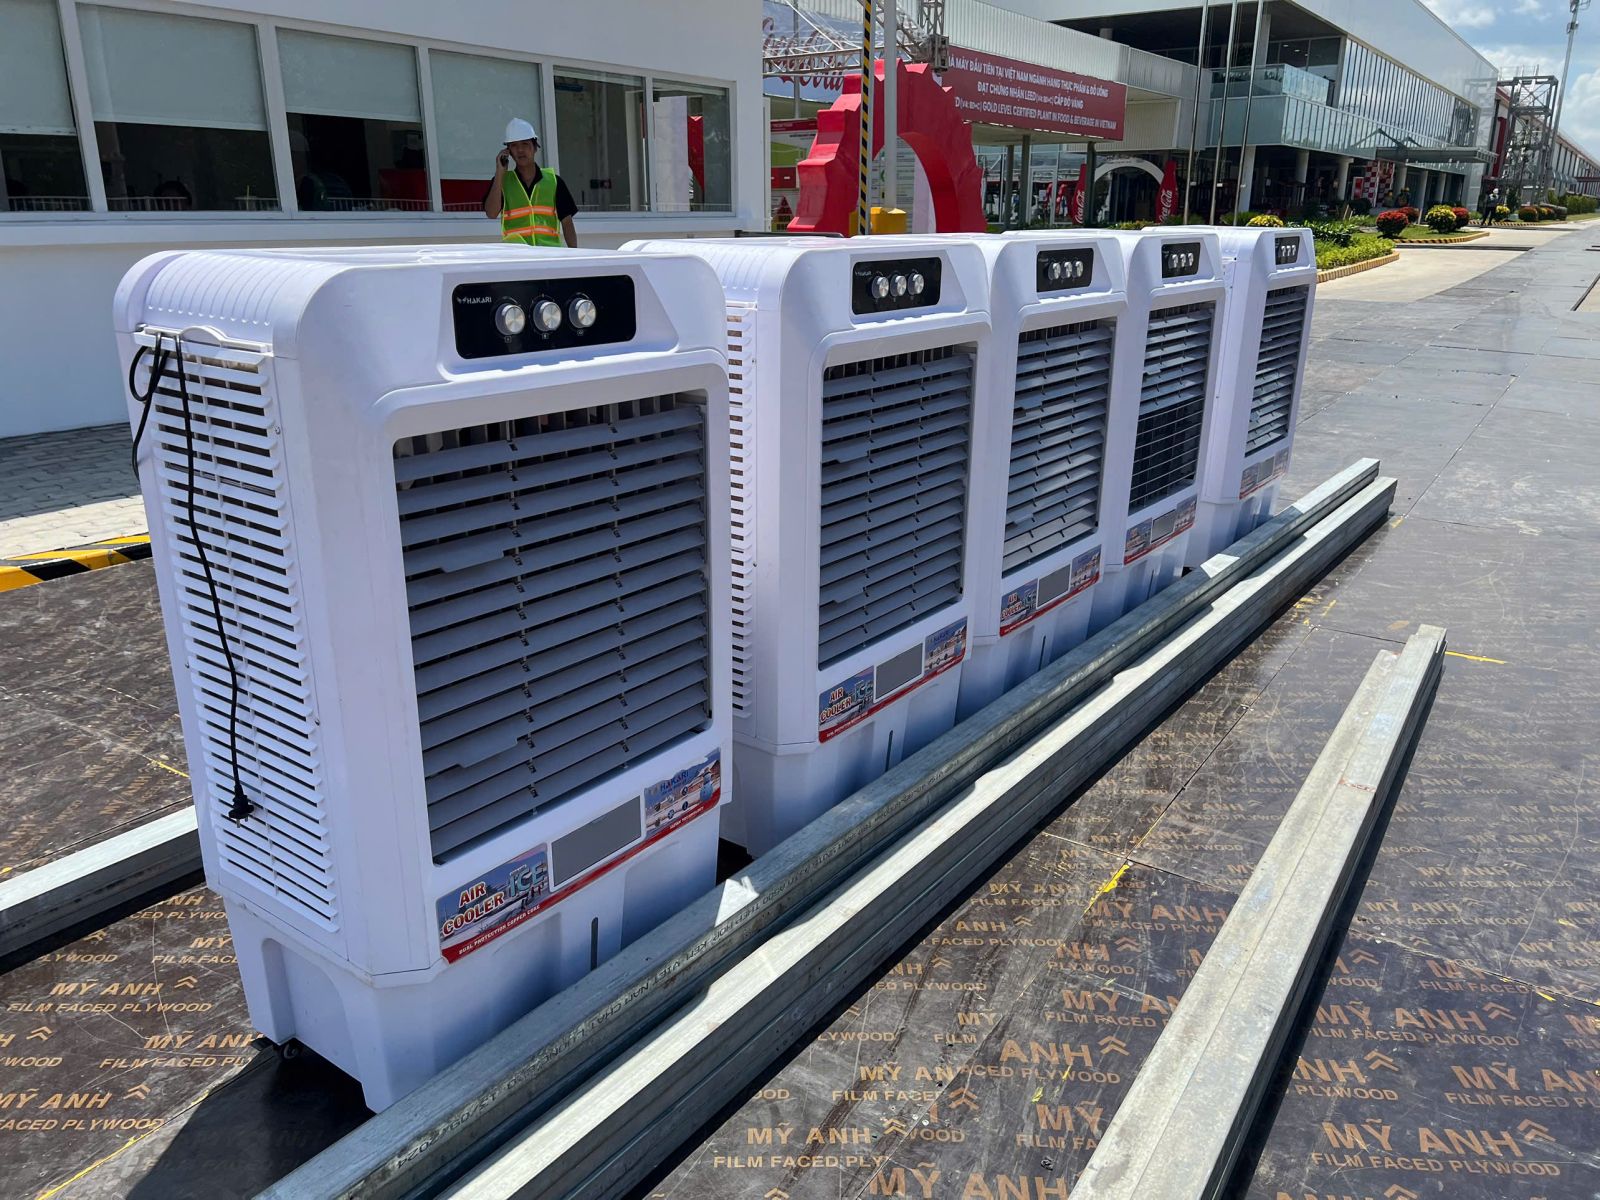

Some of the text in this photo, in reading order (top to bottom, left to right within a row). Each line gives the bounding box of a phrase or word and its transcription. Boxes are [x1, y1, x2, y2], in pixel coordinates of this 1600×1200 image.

[983, 102, 998, 112] GOLD
[998, 104, 1012, 114] LEVEL
[1012, 106, 1036, 118] CERTIFIED
[1038, 110, 1052, 120] PLANT
[1058, 112, 1070, 124] FOOD
[829, 686, 844, 704] AIR
[819, 696, 852, 723] COOLER
[660, 771, 690, 793] HAKARI
[508, 863, 548, 898] ICE
[459, 881, 487, 908] AIR
[442, 891, 505, 937] COOLER
[473, 925, 507, 946] PROTECTION
[507, 913, 527, 927] COPPER
[956, 920, 1007, 932] ANH
[1111, 920, 1166, 932] FACED
[932, 938, 984, 947] FACED
[151, 955, 196, 964] FILM
[1048, 961, 1136, 976] PLYWOOD
[50, 978, 164, 996] MỸ ANH
[903, 982, 988, 992] PLYWOOD
[1419, 980, 1530, 995] FILM FACED
[6, 1002, 213, 1013] FILM FACED PLYWOOD
[1062, 985, 1120, 1012] MỸ
[1044, 1012, 1156, 1028] FILM FACED
[1315, 1000, 1488, 1032] MỸ ANH
[143, 1029, 194, 1050] MỸ
[934, 1033, 978, 1045] FILM
[1351, 1030, 1521, 1047] FACED PLYWOOD
[999, 1039, 1094, 1068] ANH
[100, 1058, 152, 1070] FILM
[152, 1056, 217, 1069] FACED
[859, 1061, 901, 1082] MỸ
[1021, 1066, 1121, 1085] PLYWOOD
[1450, 1061, 1521, 1091] MỸ
[38, 1093, 113, 1109] ANH
[832, 1090, 878, 1102] FILM
[1296, 1084, 1400, 1102] PLYWOOD
[1443, 1092, 1494, 1106] FILM
[1499, 1094, 1570, 1110] FACED
[61, 1118, 166, 1131] PLYWOOD
[1035, 1099, 1104, 1138] MỸ
[746, 1121, 872, 1145] MỸ ANH
[1015, 1133, 1066, 1151] FILM
[1320, 1117, 1525, 1158] MỸ ANH
[713, 1155, 764, 1169] FILM
[770, 1155, 840, 1169] FACED
[1311, 1152, 1562, 1178] FILM FACED PLYWOOD
[868, 1161, 1070, 1200] MỸ ANH
